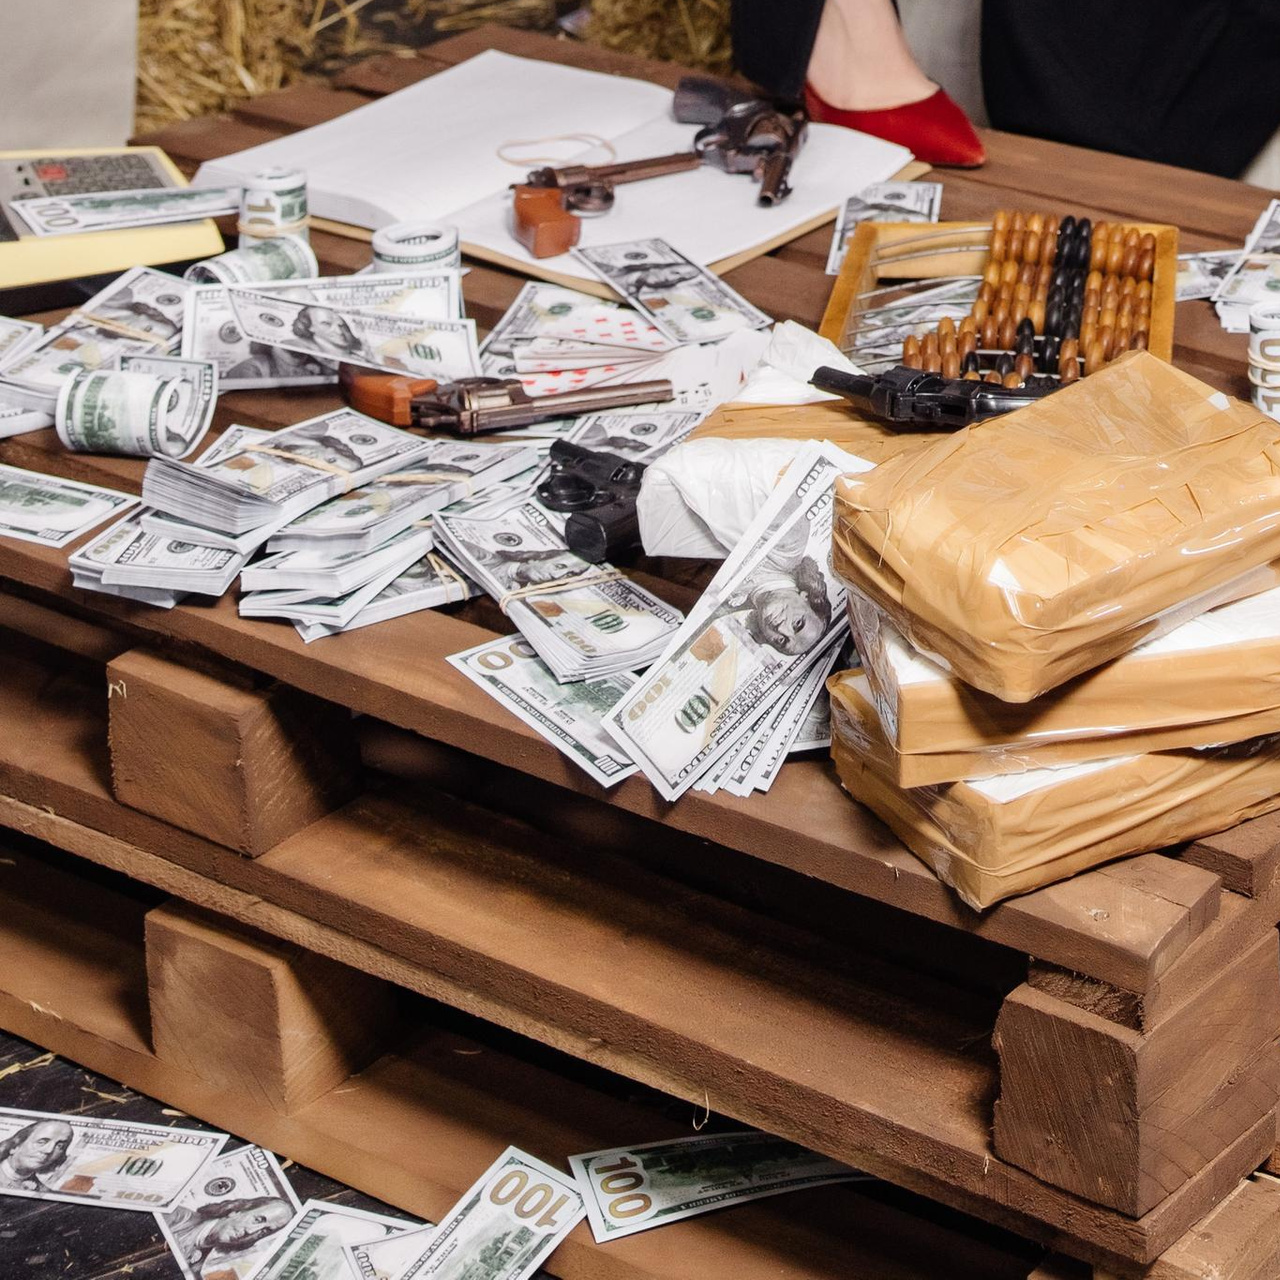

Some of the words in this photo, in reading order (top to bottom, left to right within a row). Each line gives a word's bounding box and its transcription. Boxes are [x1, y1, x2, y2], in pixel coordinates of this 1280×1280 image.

[37, 203, 78, 228] 100
[652, 603, 677, 625] 100
[561, 630, 598, 654] 100
[477, 641, 539, 670] 00
[628, 674, 672, 721] 100
[595, 755, 620, 776] 100
[678, 745, 712, 779] 100
[250, 1146, 269, 1170] 100
[116, 1190, 163, 1203] 100
[489, 1169, 571, 1228] 100
[596, 1156, 652, 1219] 100
